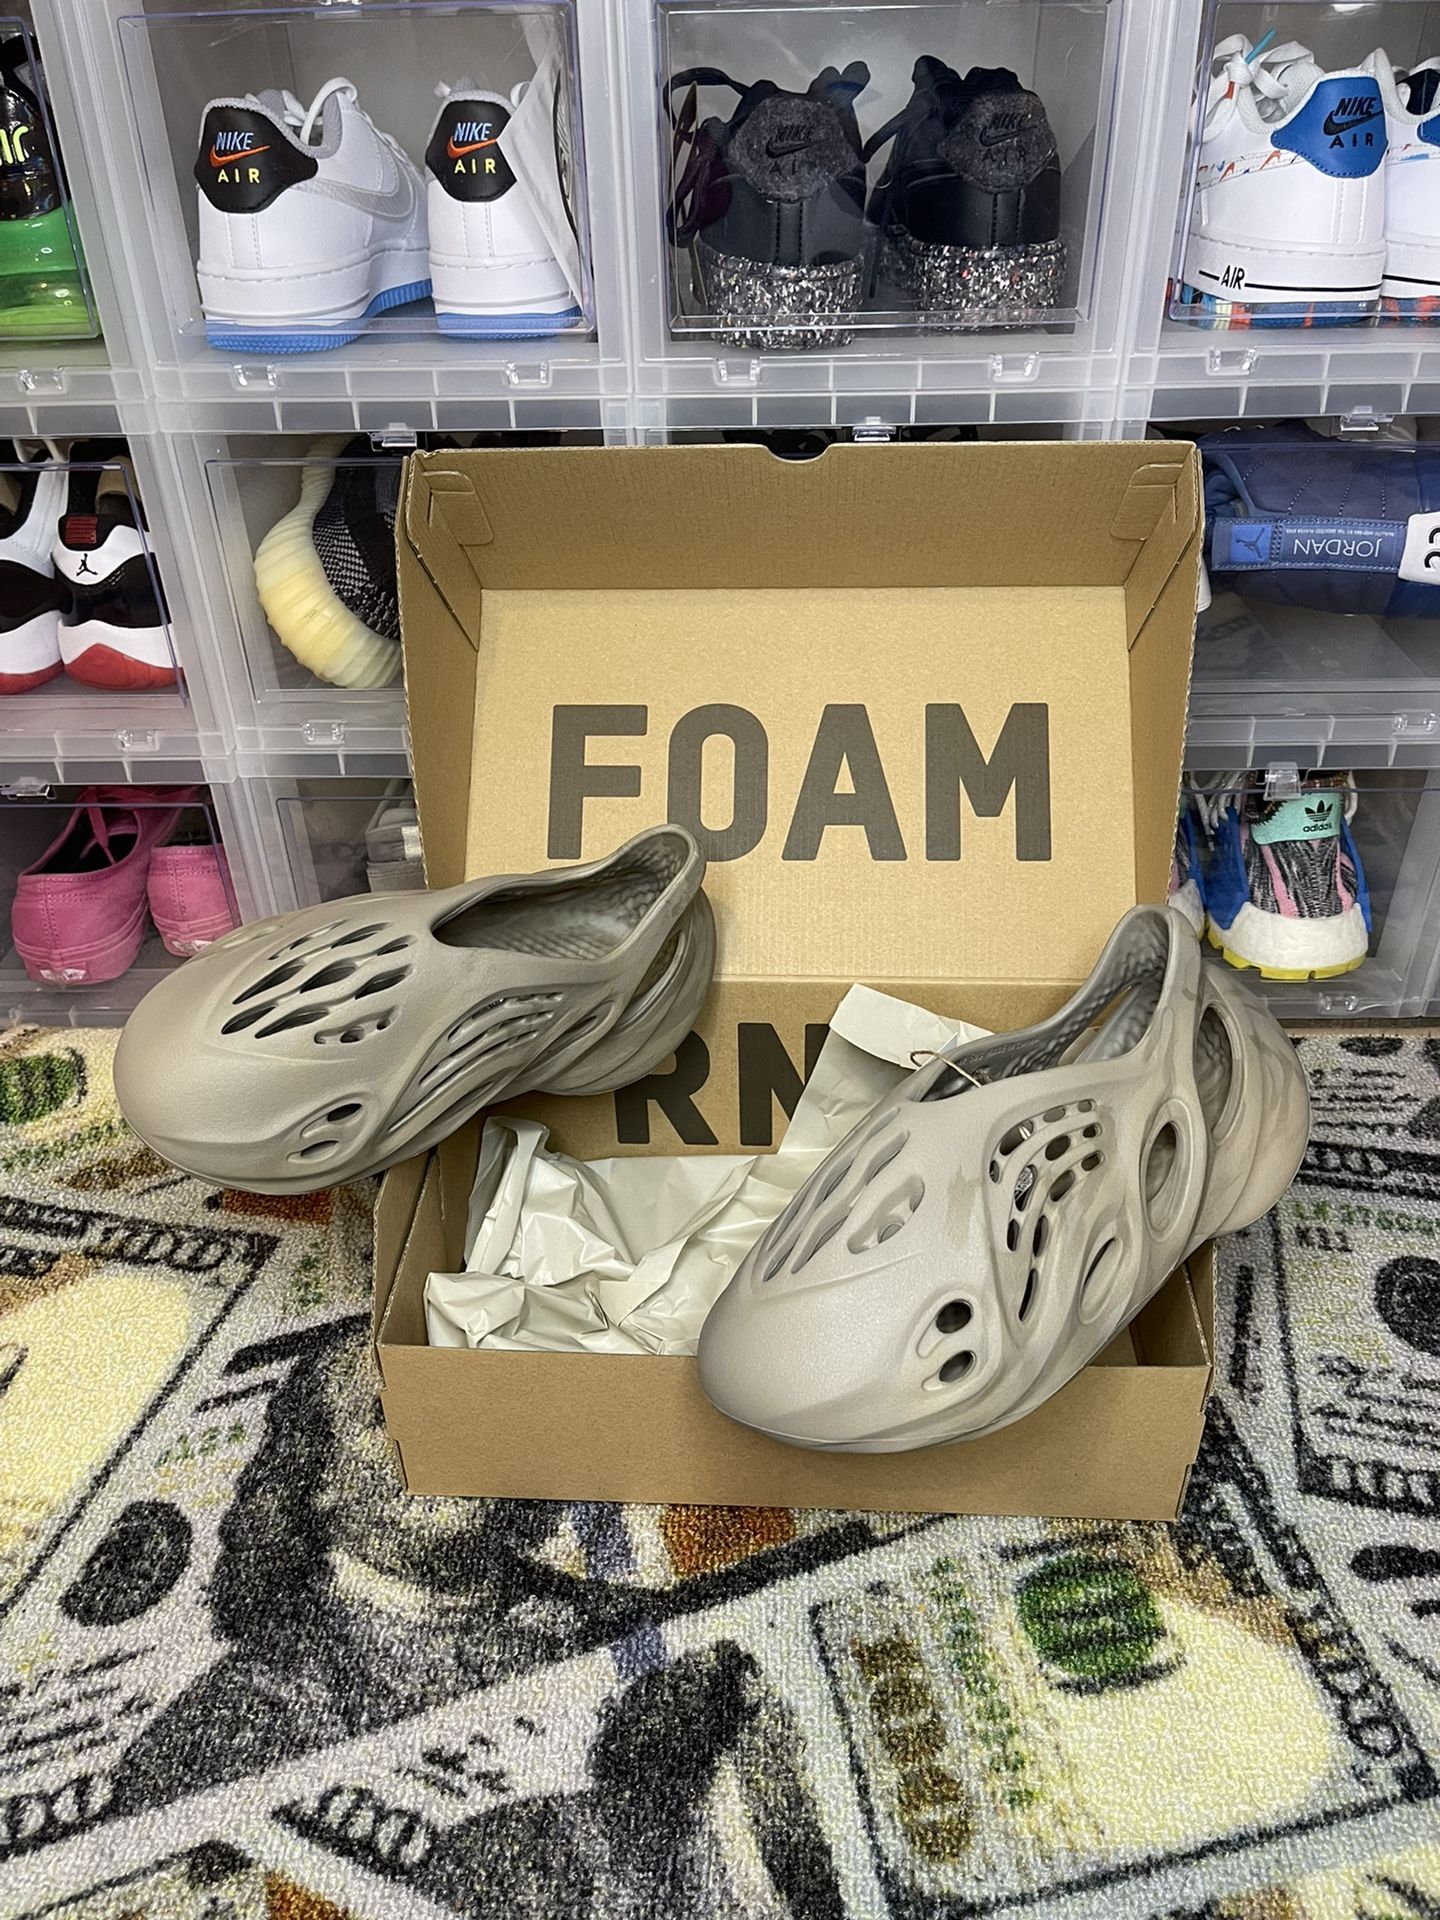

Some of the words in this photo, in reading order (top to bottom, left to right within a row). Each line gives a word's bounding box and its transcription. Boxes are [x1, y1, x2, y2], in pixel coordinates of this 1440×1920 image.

[1333, 96, 1377, 117] NIKE
[215, 131, 254, 151] NIKE
[453, 122, 492, 142] NIKE
[1329, 132, 1374, 149] AIR
[217, 168, 260, 183] AIR
[454, 158, 496, 174] AIR
[1220, 264, 1246, 290] AIR
[1293, 538, 1383, 558] JORDAN
[547, 703, 1052, 862] FOAM
